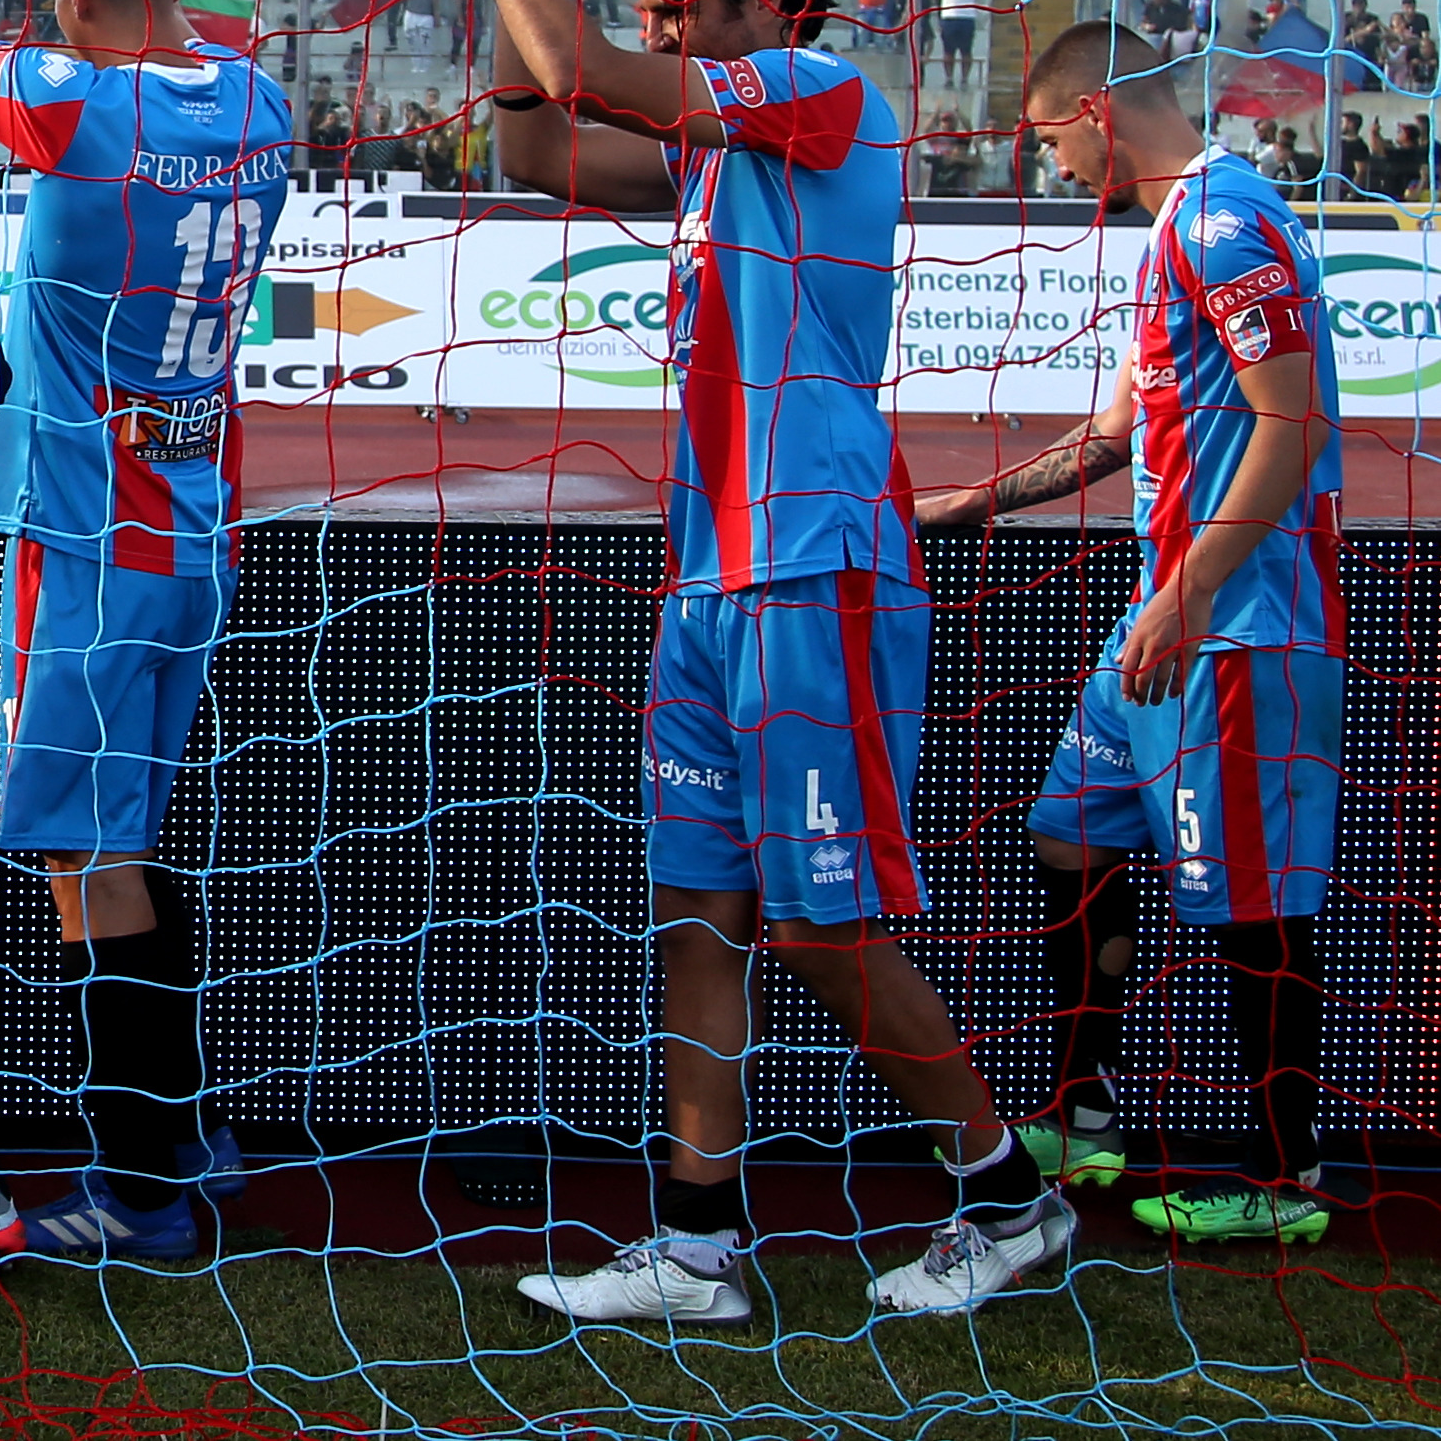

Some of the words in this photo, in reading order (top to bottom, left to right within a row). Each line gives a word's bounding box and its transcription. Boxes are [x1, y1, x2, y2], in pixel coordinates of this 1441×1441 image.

[130, 148, 289, 190] FERRARA
[154, 197, 262, 378] 13
[1038, 267, 1129, 294] Florio
[1223, 269, 1283, 308] BACCO
[890, 304, 1069, 331] isterbianco
[901, 343, 943, 368] Tel
[954, 343, 1118, 371] 095472553
[235, 363, 409, 390] ICIO
[143, 443, 211, 461] RESTAURANT
[806, 768, 840, 840] 4
[1176, 788, 1202, 853] 5
